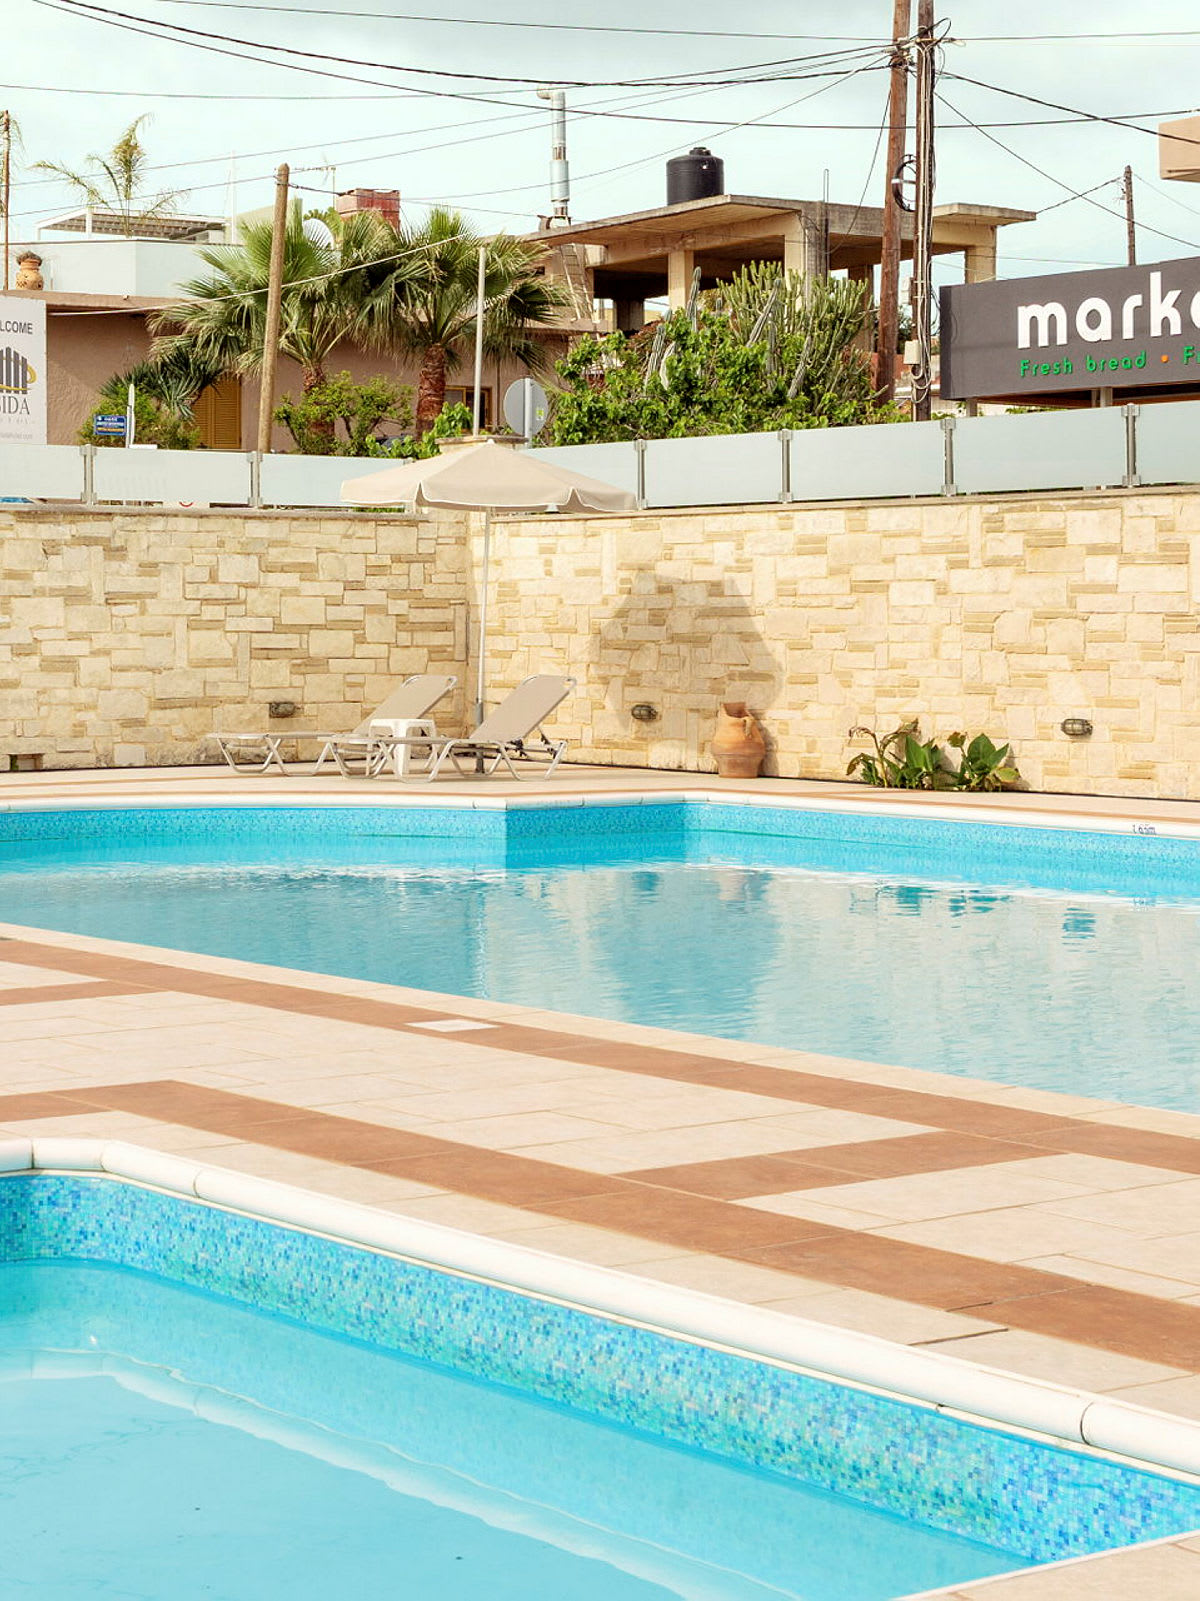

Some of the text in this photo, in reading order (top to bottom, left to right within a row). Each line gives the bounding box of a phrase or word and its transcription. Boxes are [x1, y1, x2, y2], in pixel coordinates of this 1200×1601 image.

[1017, 271, 1200, 349] mark
[1020, 356, 1073, 377] Fresh
[1085, 351, 1147, 372] bread
